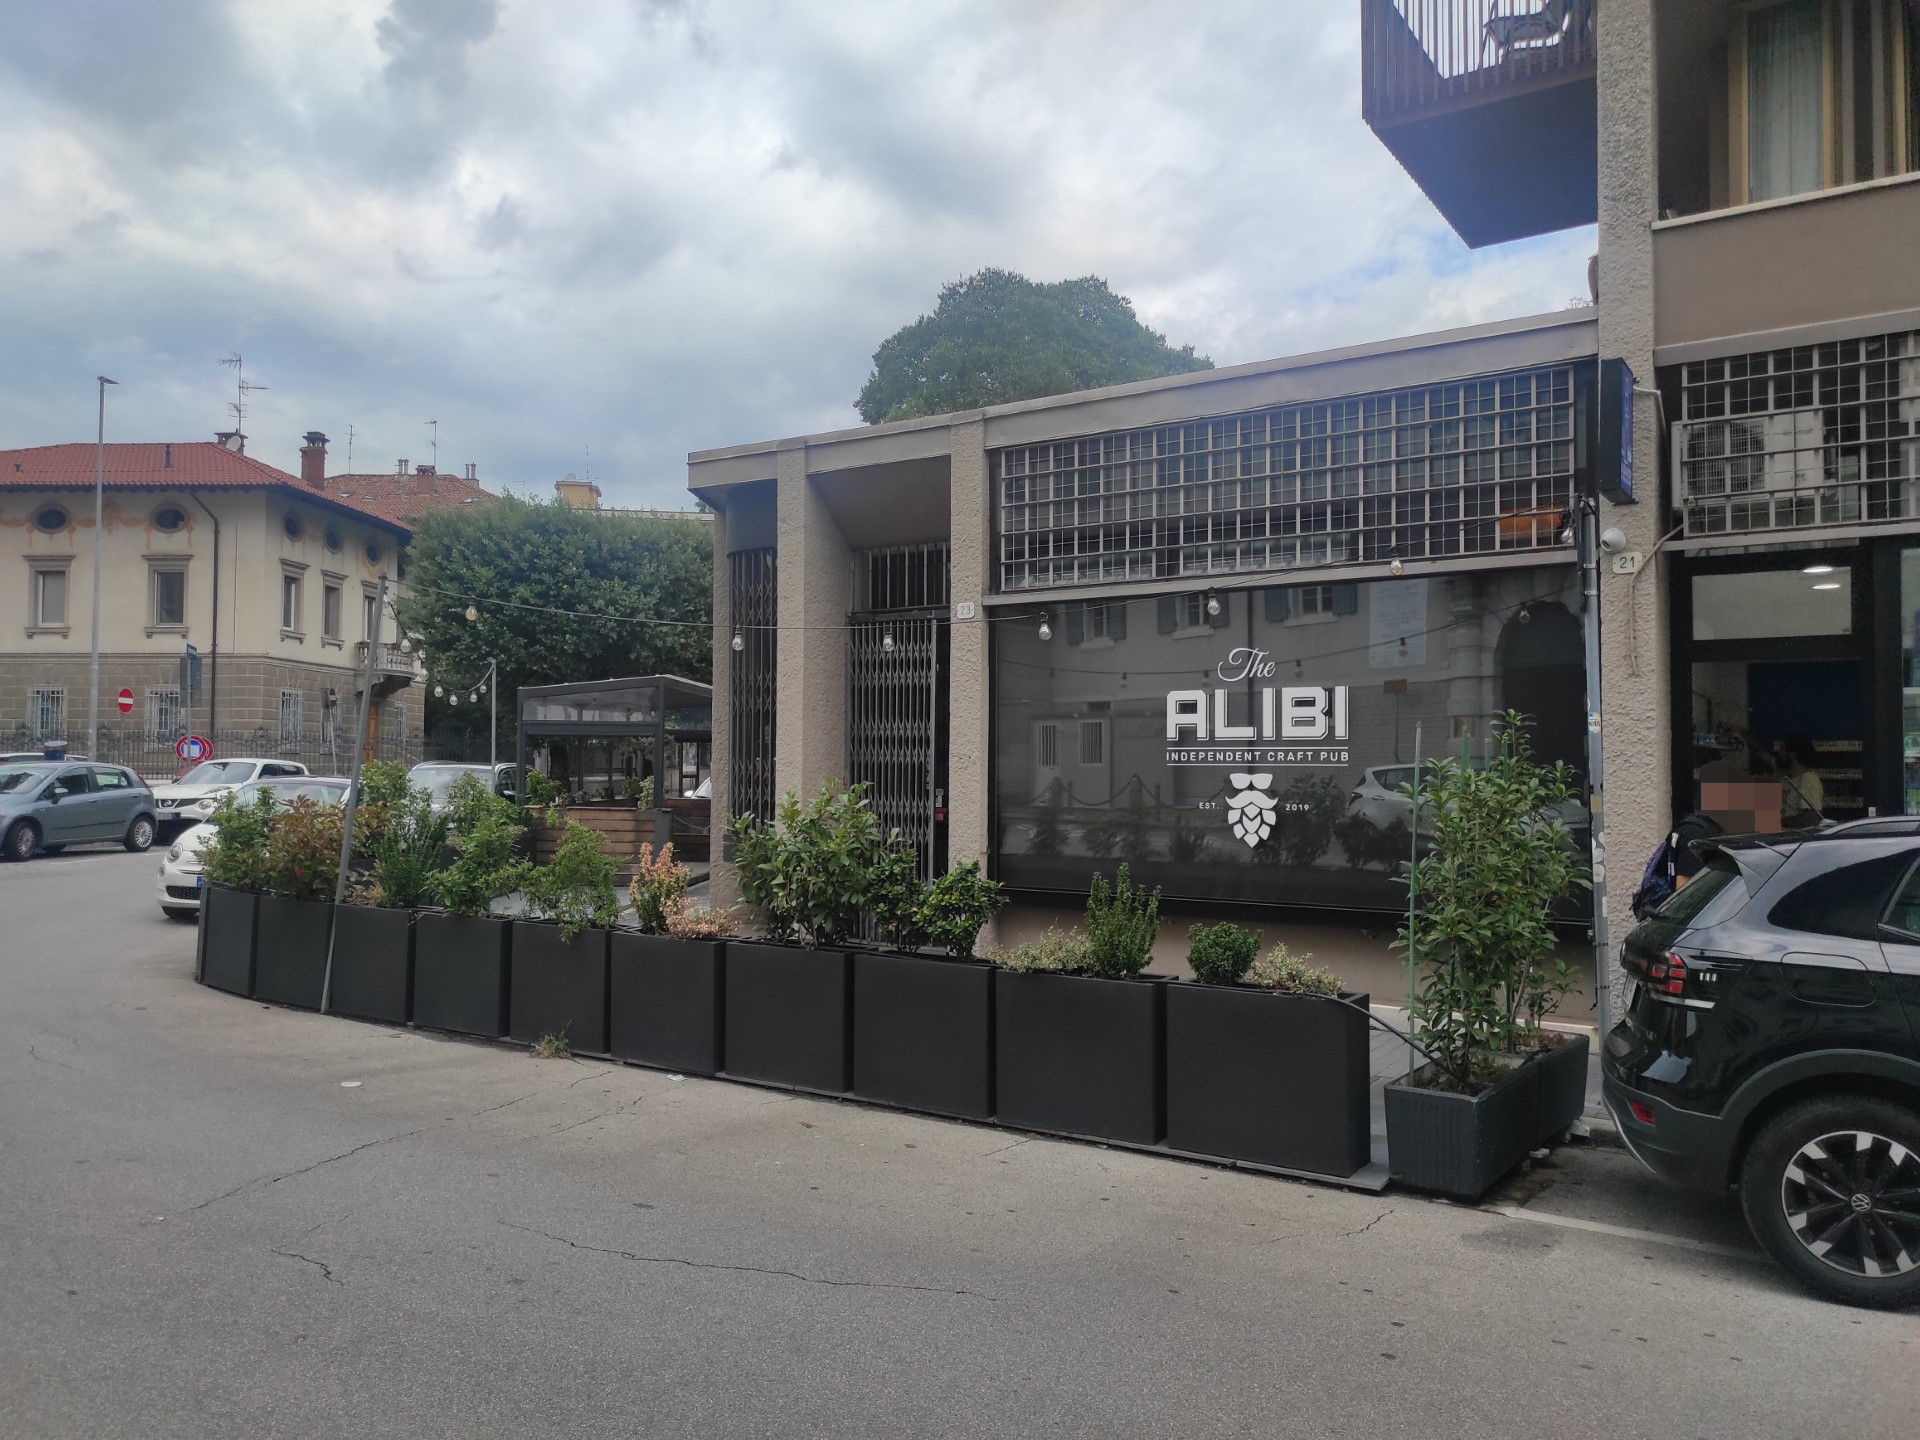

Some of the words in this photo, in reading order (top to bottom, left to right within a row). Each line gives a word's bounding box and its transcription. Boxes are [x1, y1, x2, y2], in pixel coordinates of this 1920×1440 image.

[1620, 556, 1635, 568] 21
[960, 605, 970, 616] 23
[1217, 647, 1276, 682] The
[1166, 685, 1349, 741] ALIBI
[1166, 751, 1262, 762] INDEPENDENT
[1267, 751, 1314, 762] CRAFT
[1320, 751, 1349, 762] PUB
[1285, 804, 1309, 812] 2019
